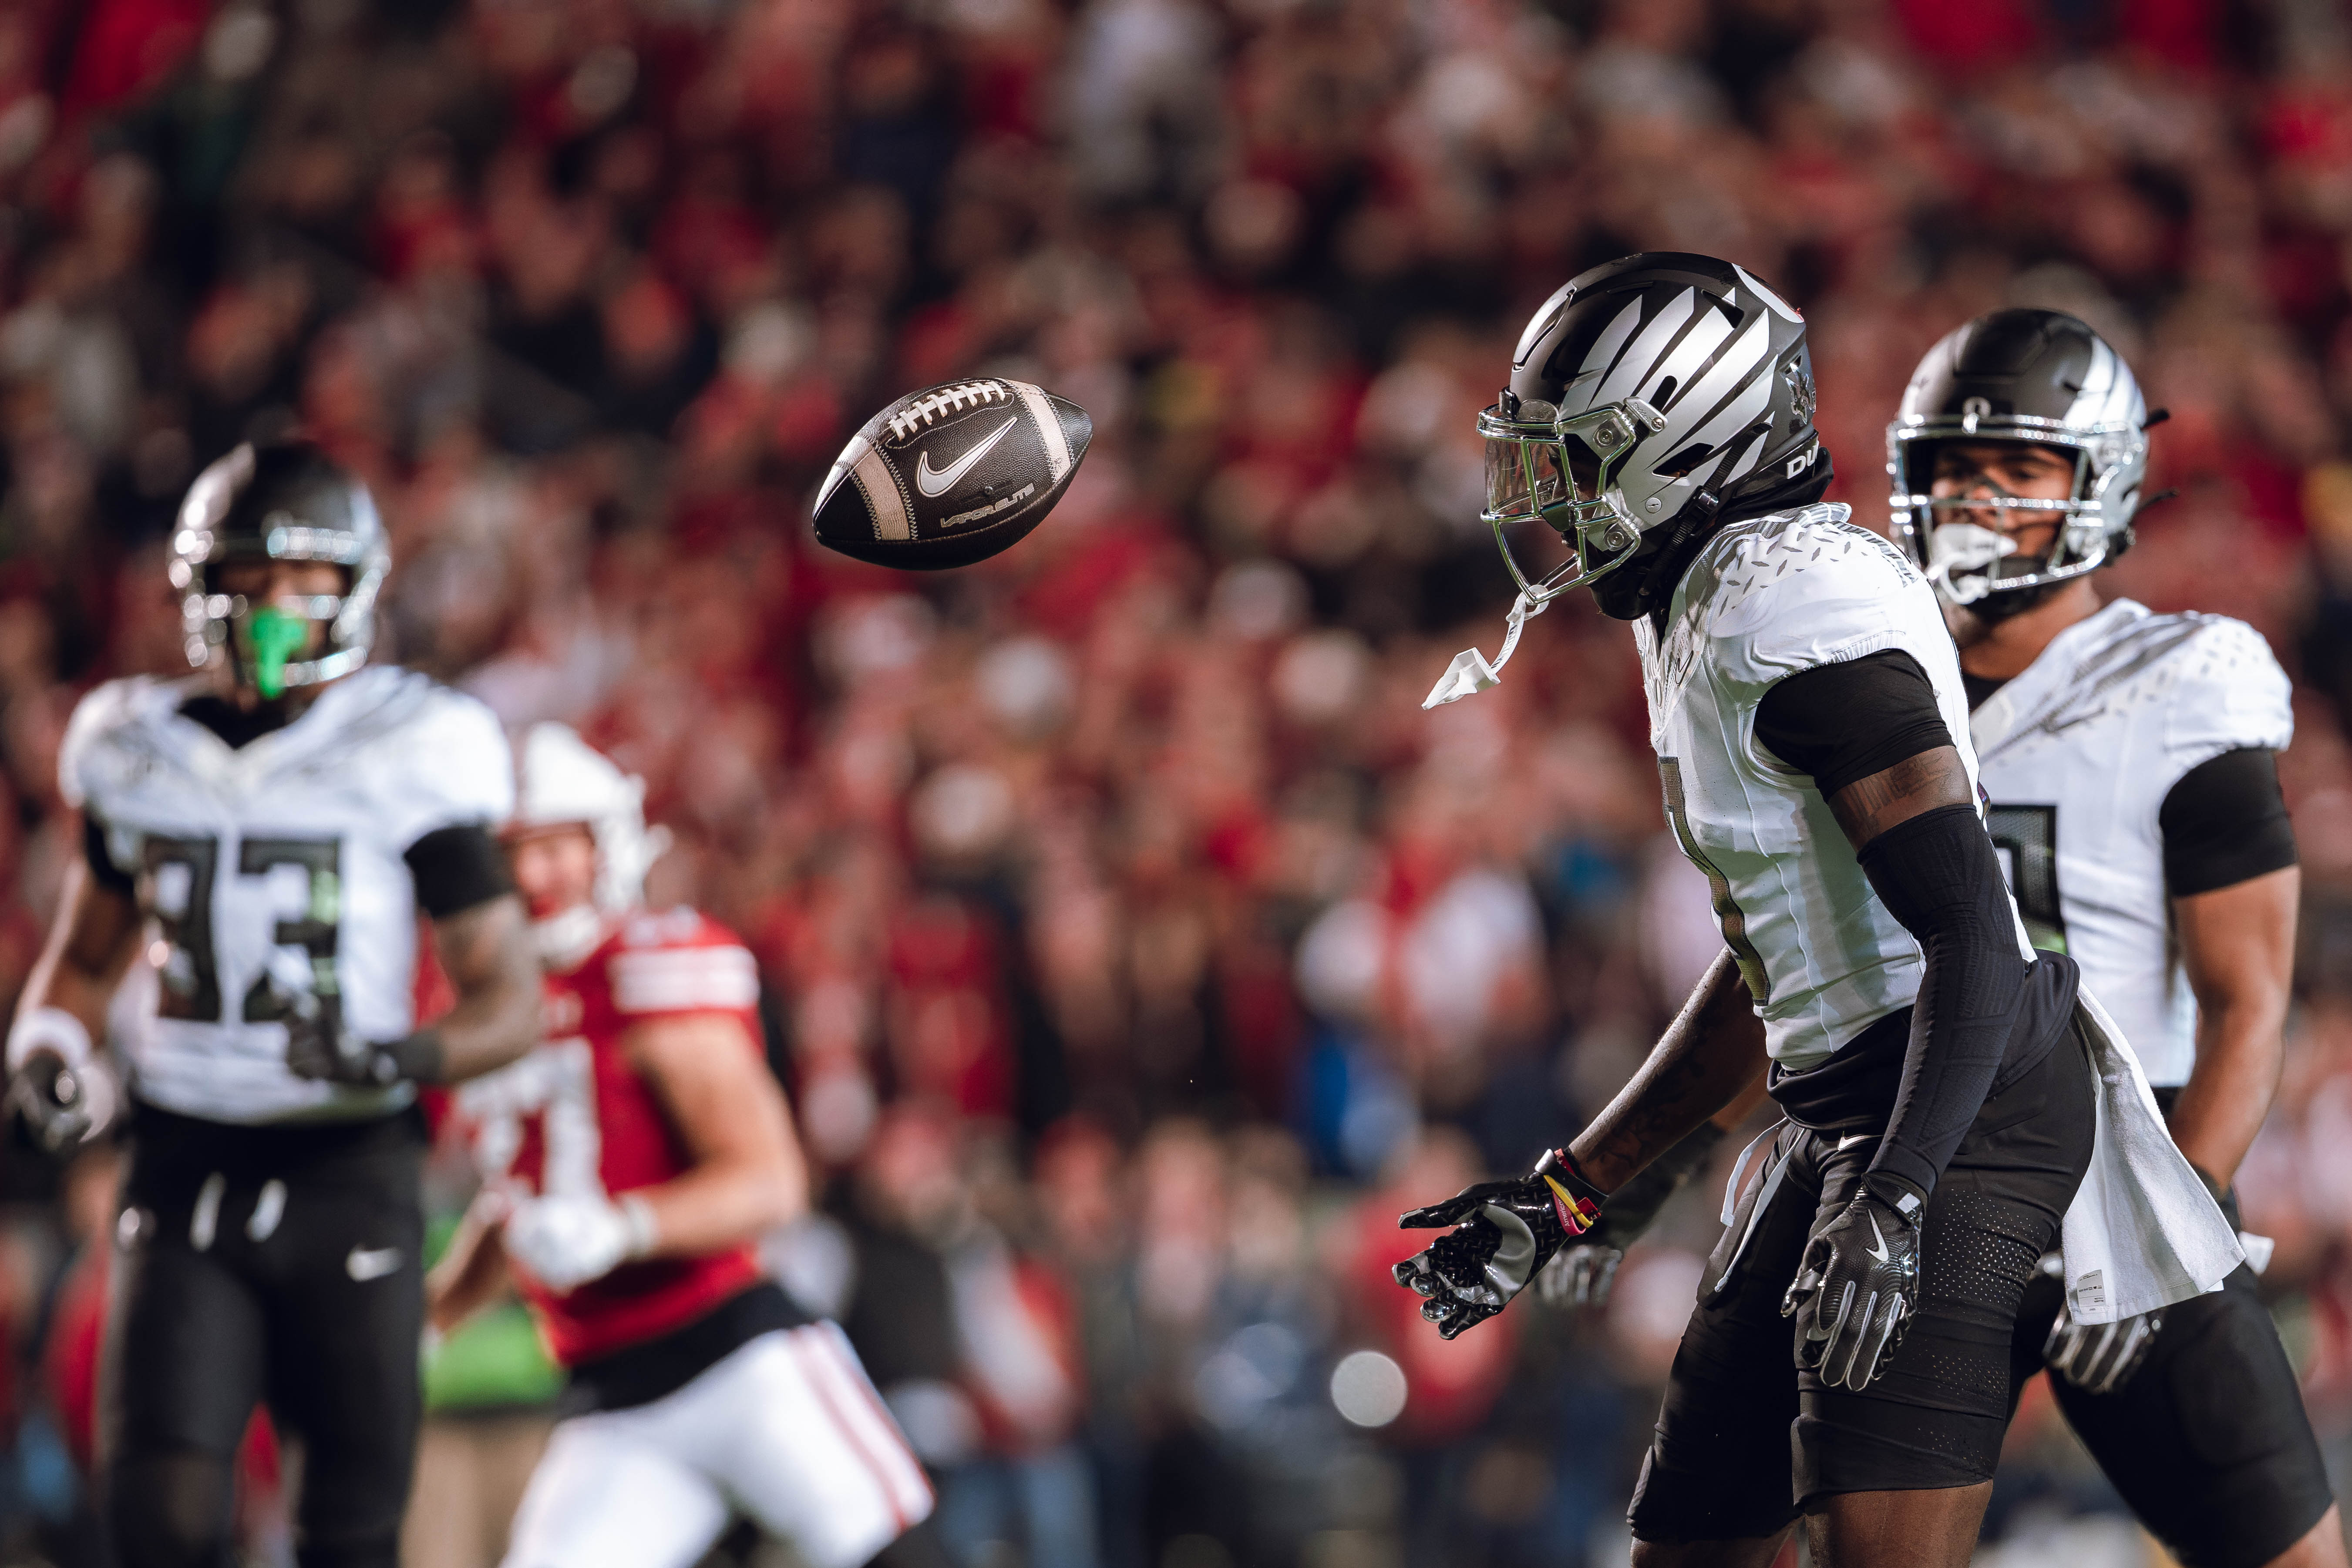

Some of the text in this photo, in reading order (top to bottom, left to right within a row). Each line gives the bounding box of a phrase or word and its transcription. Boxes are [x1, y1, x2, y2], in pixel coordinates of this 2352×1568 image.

[940, 483, 1035, 528] VAPOR ELITE
[1558, 1199, 1570, 1226] America
